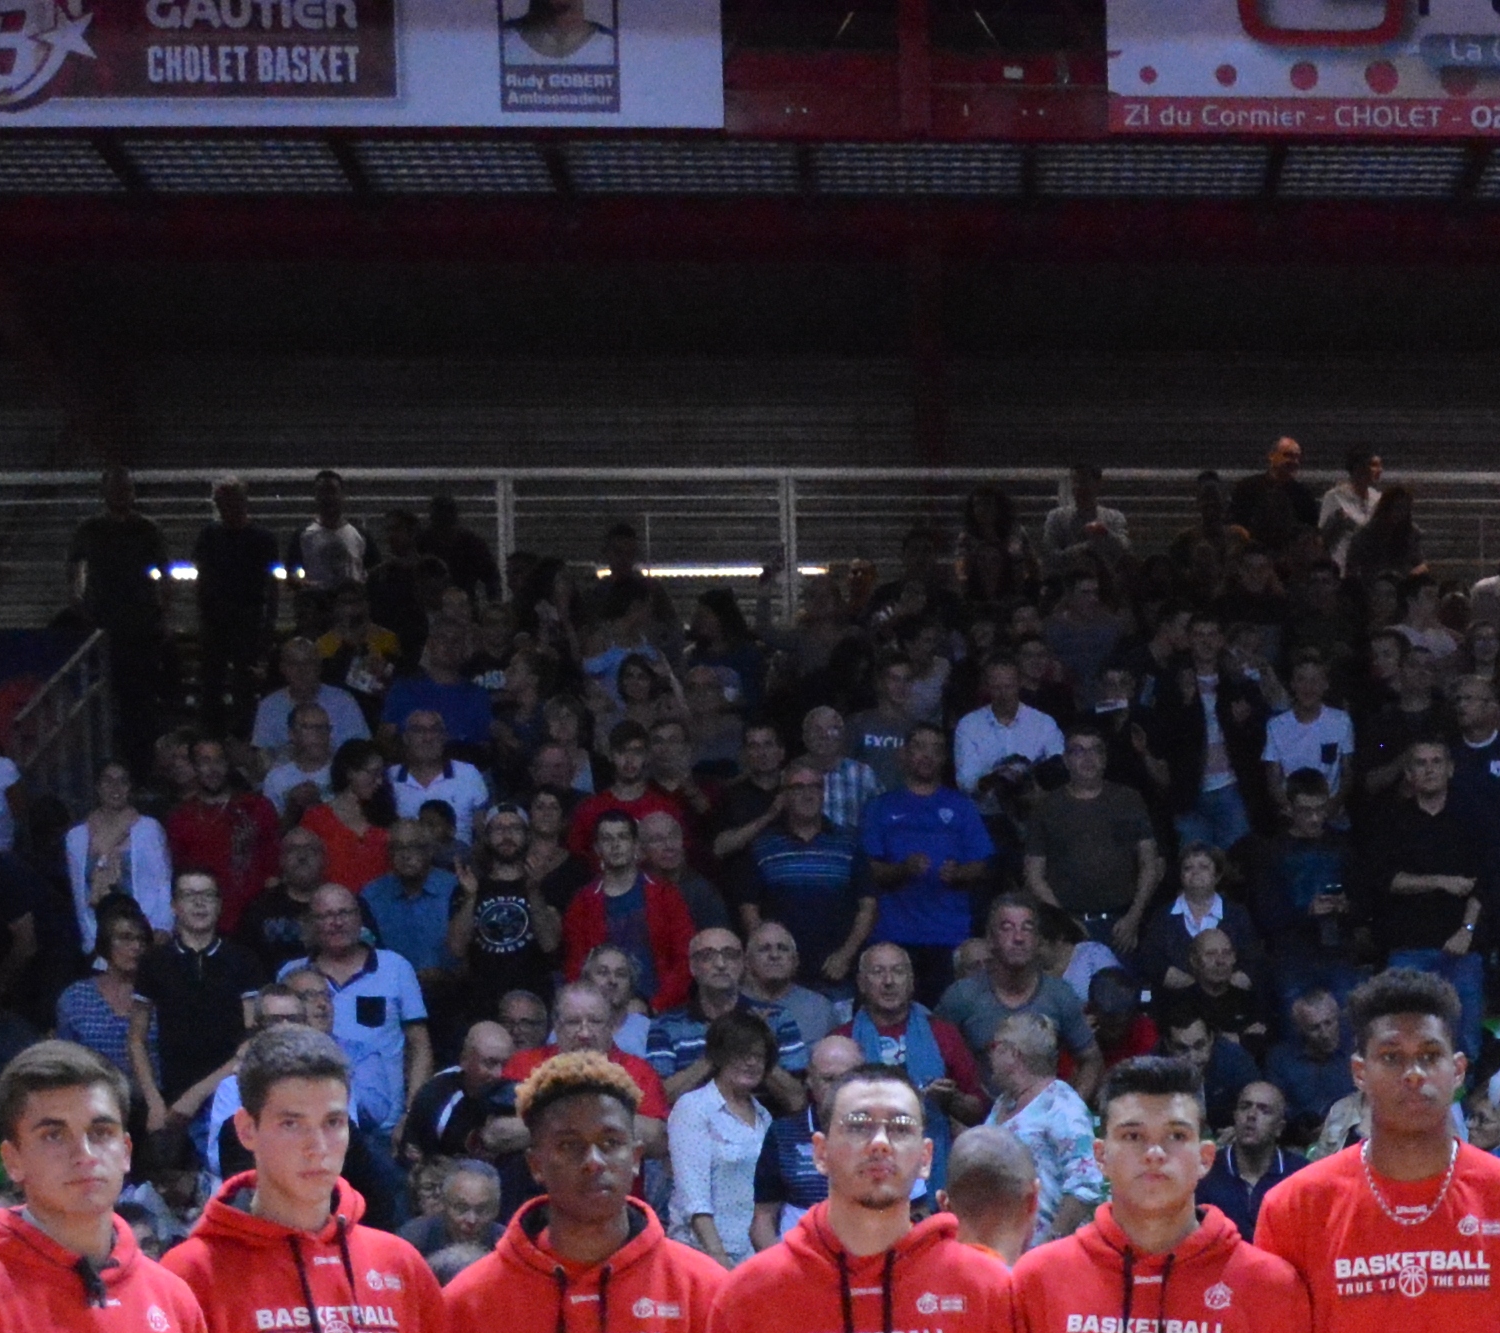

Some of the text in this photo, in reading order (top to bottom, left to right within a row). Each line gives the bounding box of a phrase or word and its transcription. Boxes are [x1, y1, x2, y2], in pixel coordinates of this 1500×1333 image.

[1449, 40, 1482, 62] La
[148, 46, 360, 84] CHOLET BASKET
[549, 74, 614, 88] GOBERT
[1159, 105, 1192, 127] du
[1202, 105, 1307, 128] Cormier
[1334, 105, 1442, 129] CHOLET
[1334, 1250, 1491, 1279] BASKETBALL
[1336, 1274, 1491, 1296] TRUE TO THE GAME
